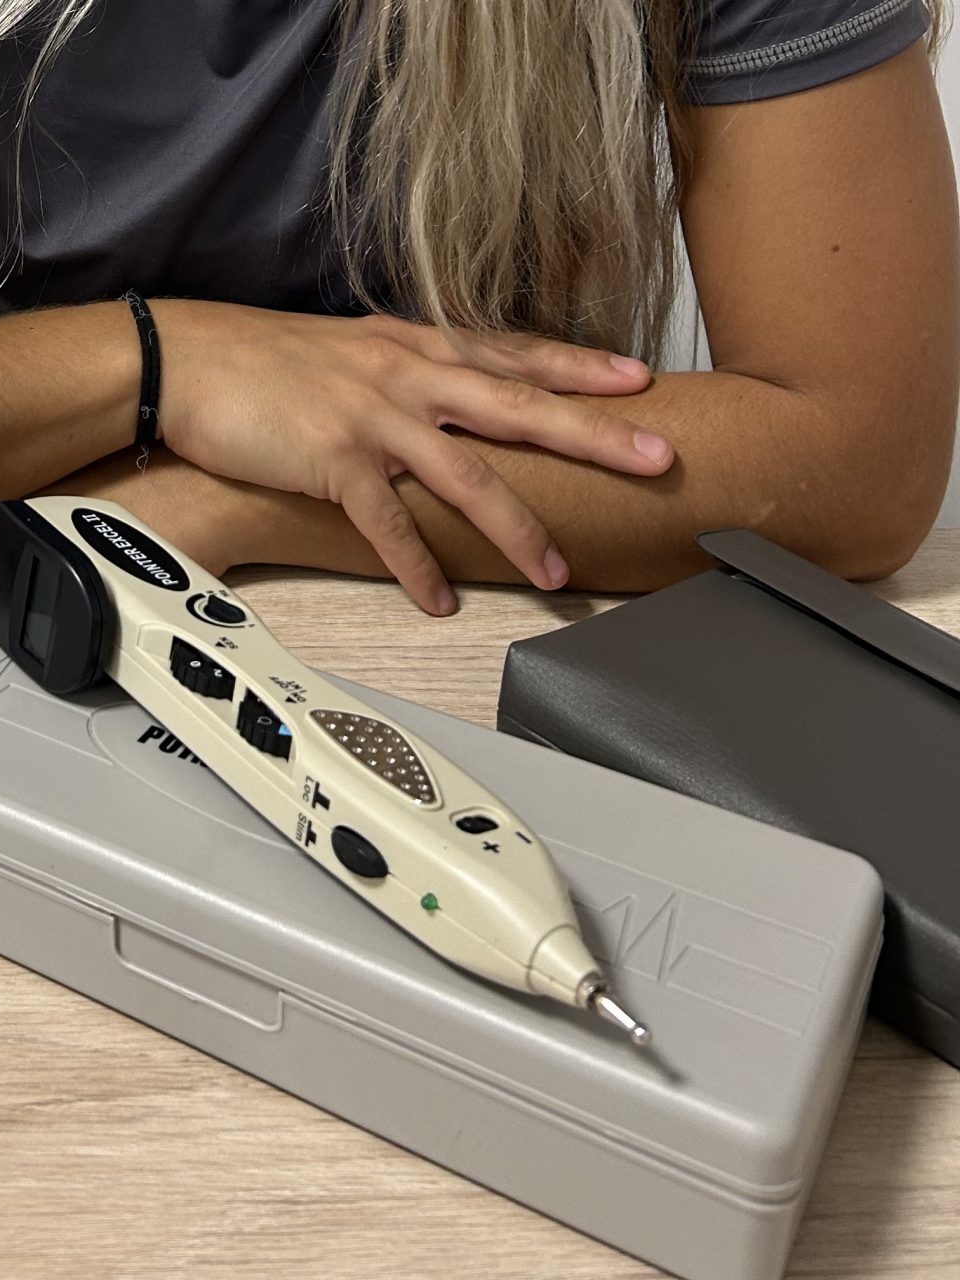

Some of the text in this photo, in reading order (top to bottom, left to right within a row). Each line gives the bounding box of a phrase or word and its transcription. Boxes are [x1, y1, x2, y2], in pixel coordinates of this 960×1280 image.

[94, 523, 134, 551] EXCEL
[123, 543, 179, 586] POINTER
[302, 774, 314, 802] Loc
[295, 812, 308, 842] Stim
